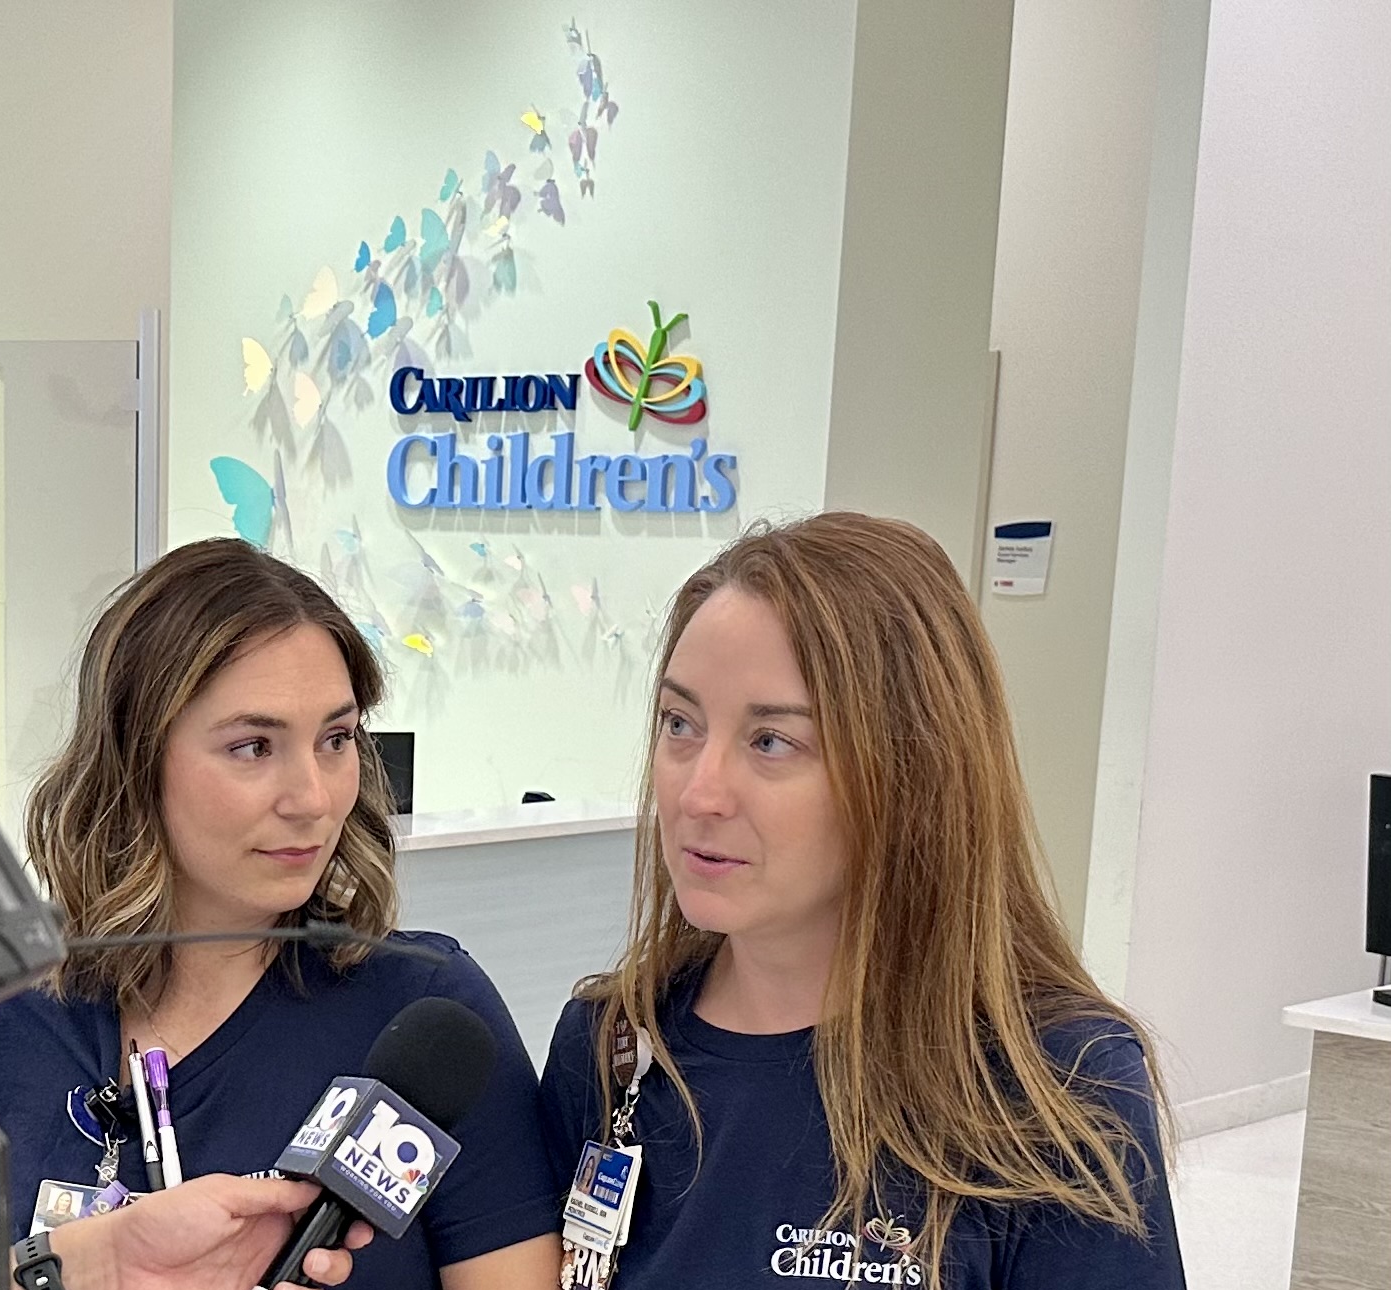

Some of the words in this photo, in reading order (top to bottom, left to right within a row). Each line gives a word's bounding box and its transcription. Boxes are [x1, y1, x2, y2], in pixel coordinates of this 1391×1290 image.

[389, 366, 580, 422] CARILION
[387, 431, 738, 513] Children's
[307, 1086, 358, 1132] 10
[297, 1131, 331, 1148] NEWS
[356, 1100, 436, 1181] 10
[344, 1146, 411, 1205] NEWS
[771, 1246, 922, 1286] Children's
